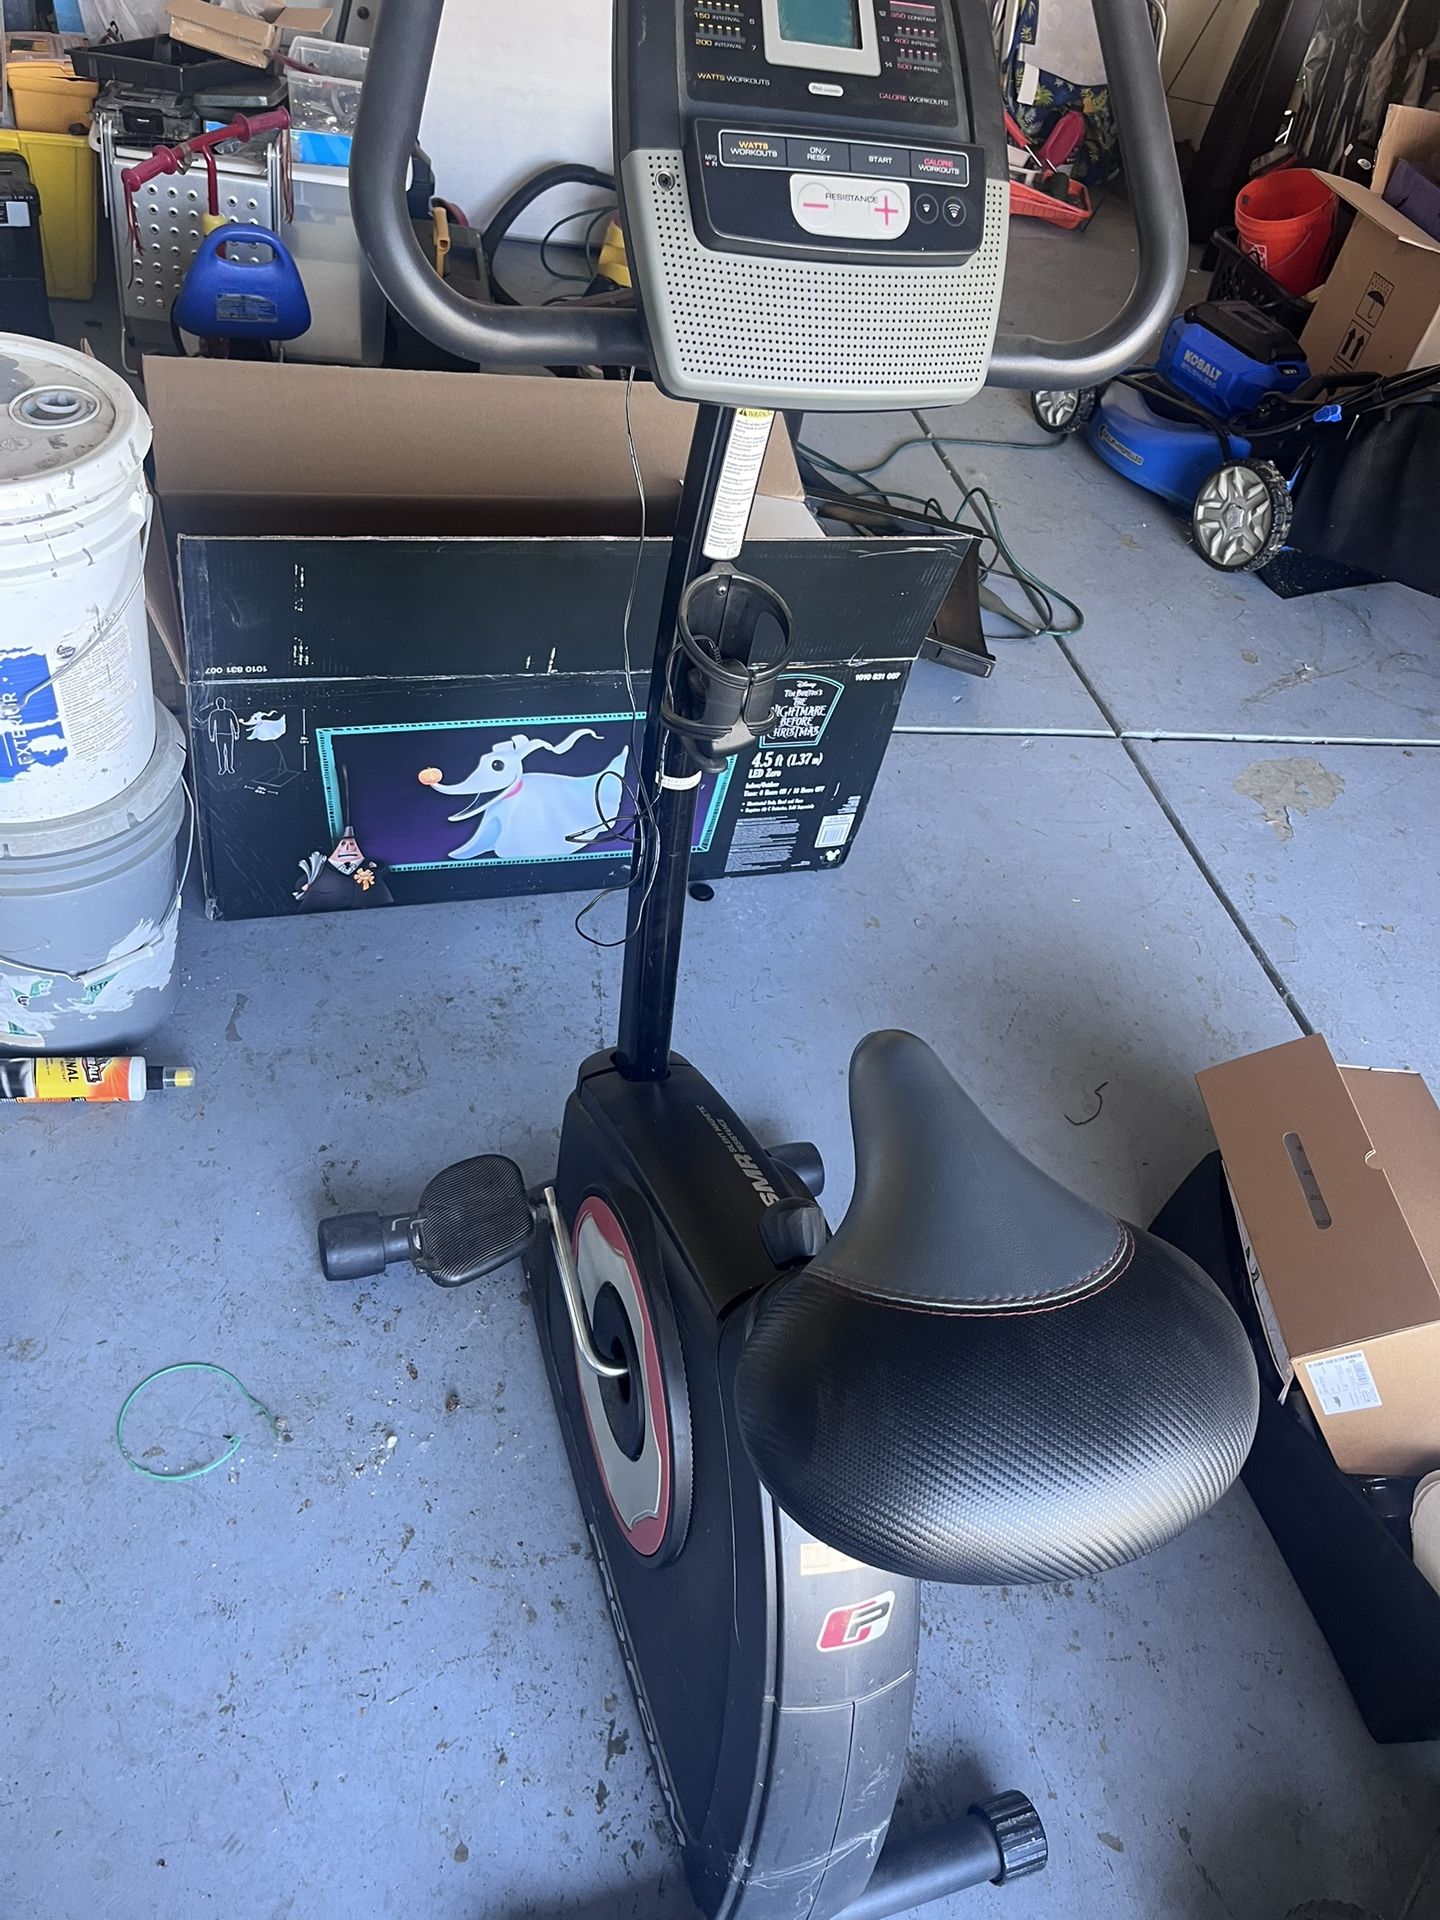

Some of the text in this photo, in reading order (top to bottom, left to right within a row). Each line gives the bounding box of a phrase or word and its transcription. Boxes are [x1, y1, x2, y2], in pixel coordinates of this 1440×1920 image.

[694, 12, 710, 20] 150
[712, 15, 741, 23] INTERVAL
[695, 38, 712, 46] 200
[714, 42, 743, 50] INTERVAL
[911, 40, 937, 48] INTERVAL
[913, 66, 939, 74] INTERVAL
[697, 73, 770, 86] WATTS WORKOUTS
[908, 96, 949, 106] WORKOUTS
[739, 141, 769, 150] WATTS
[810, 146, 827, 154] ON/
[730, 148, 777, 158] WORKOUTS
[807, 153, 831, 162] RESET
[868, 156, 892, 164] START
[924, 158, 954, 167] CALORIE
[918, 164, 960, 175] WORKOUTS
[825, 192, 878, 204] RESISTANCE
[1183, 350, 1222, 382] KOBALT
[226, 666, 243, 674] 831
[855, 673, 872, 681] 1010
[792, 697, 807, 706] THE
[778, 716, 814, 728] BEFORE
[752, 751, 774, 768] 4.5
[748, 768, 781, 779] LED Zero
[734, 1154, 780, 1207] SMR
